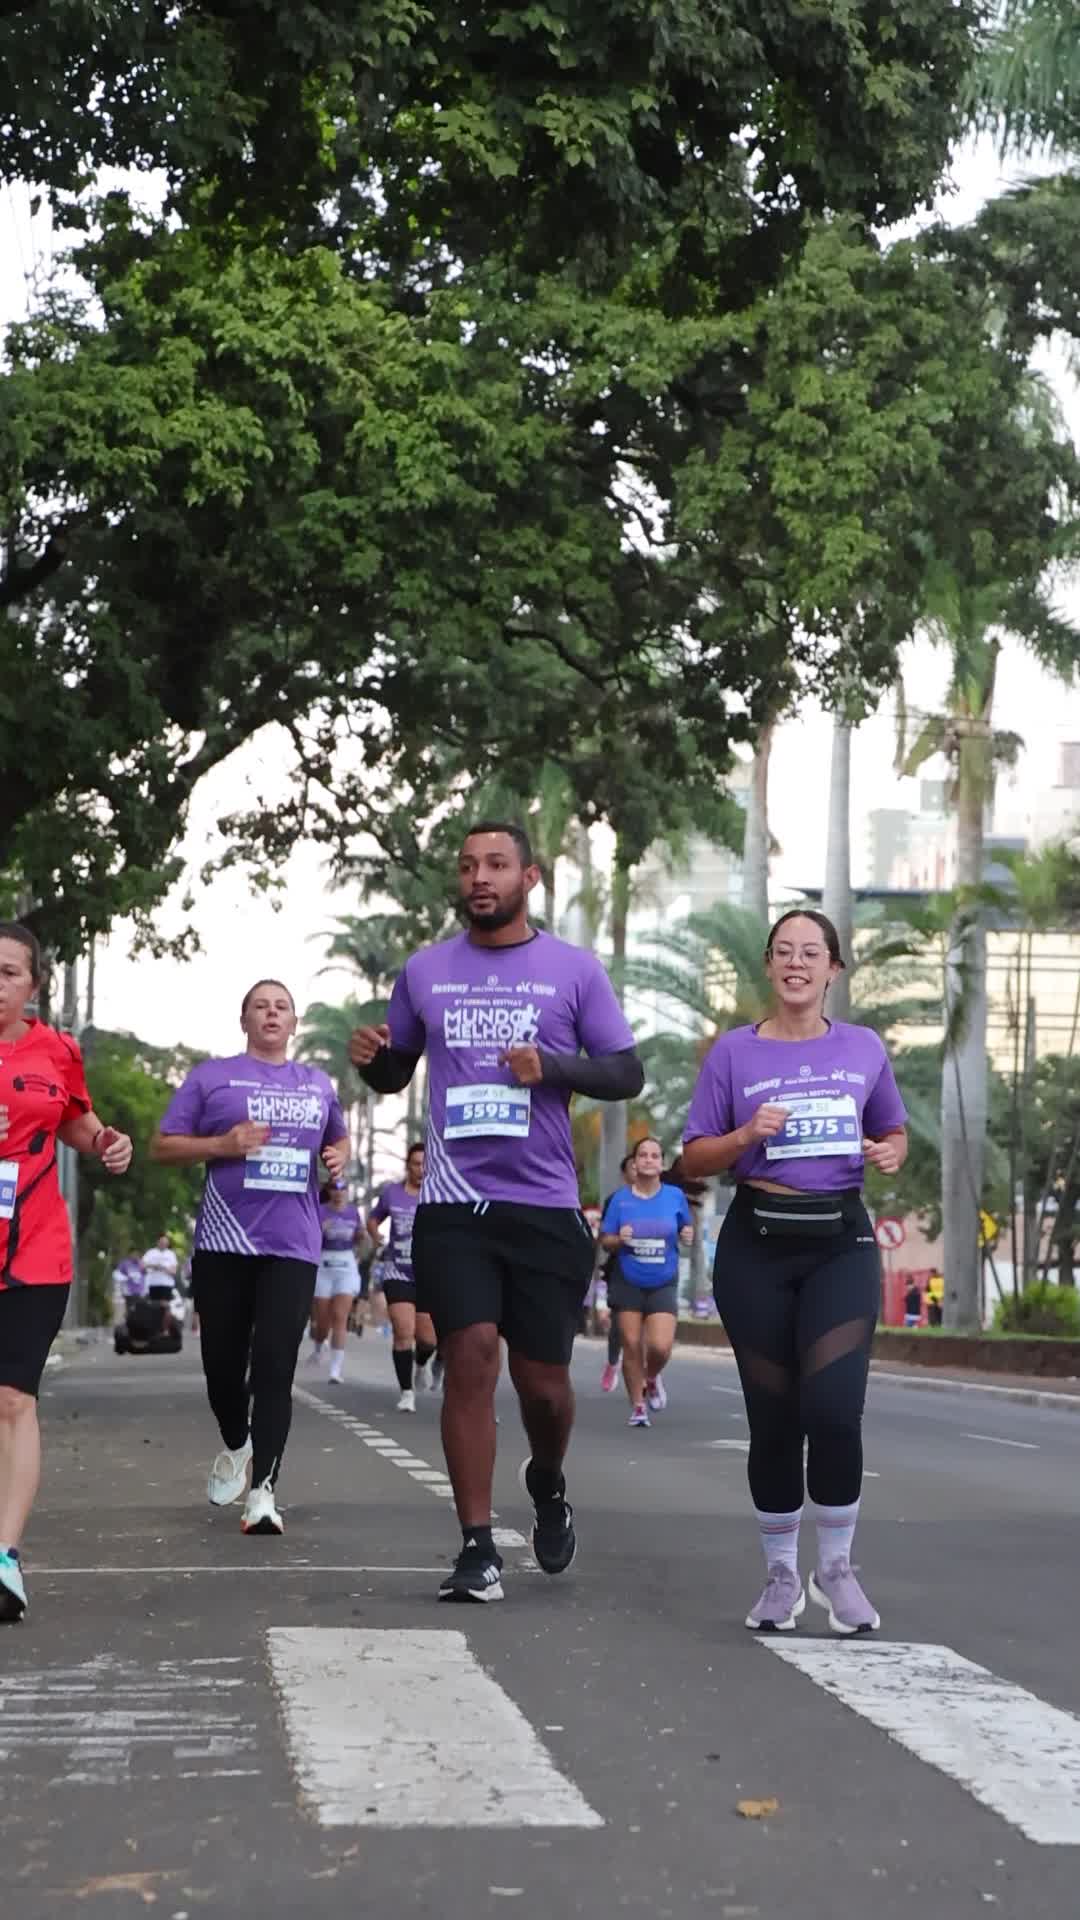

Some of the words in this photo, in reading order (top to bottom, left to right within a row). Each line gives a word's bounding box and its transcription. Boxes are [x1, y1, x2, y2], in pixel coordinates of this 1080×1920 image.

[444, 1008, 523, 1025] MUNDO
[247, 1096, 310, 1111] MUNDO
[463, 1103, 510, 1120] 5595
[785, 1119, 838, 1137] 5375
[260, 1162, 297, 1177] 6025
